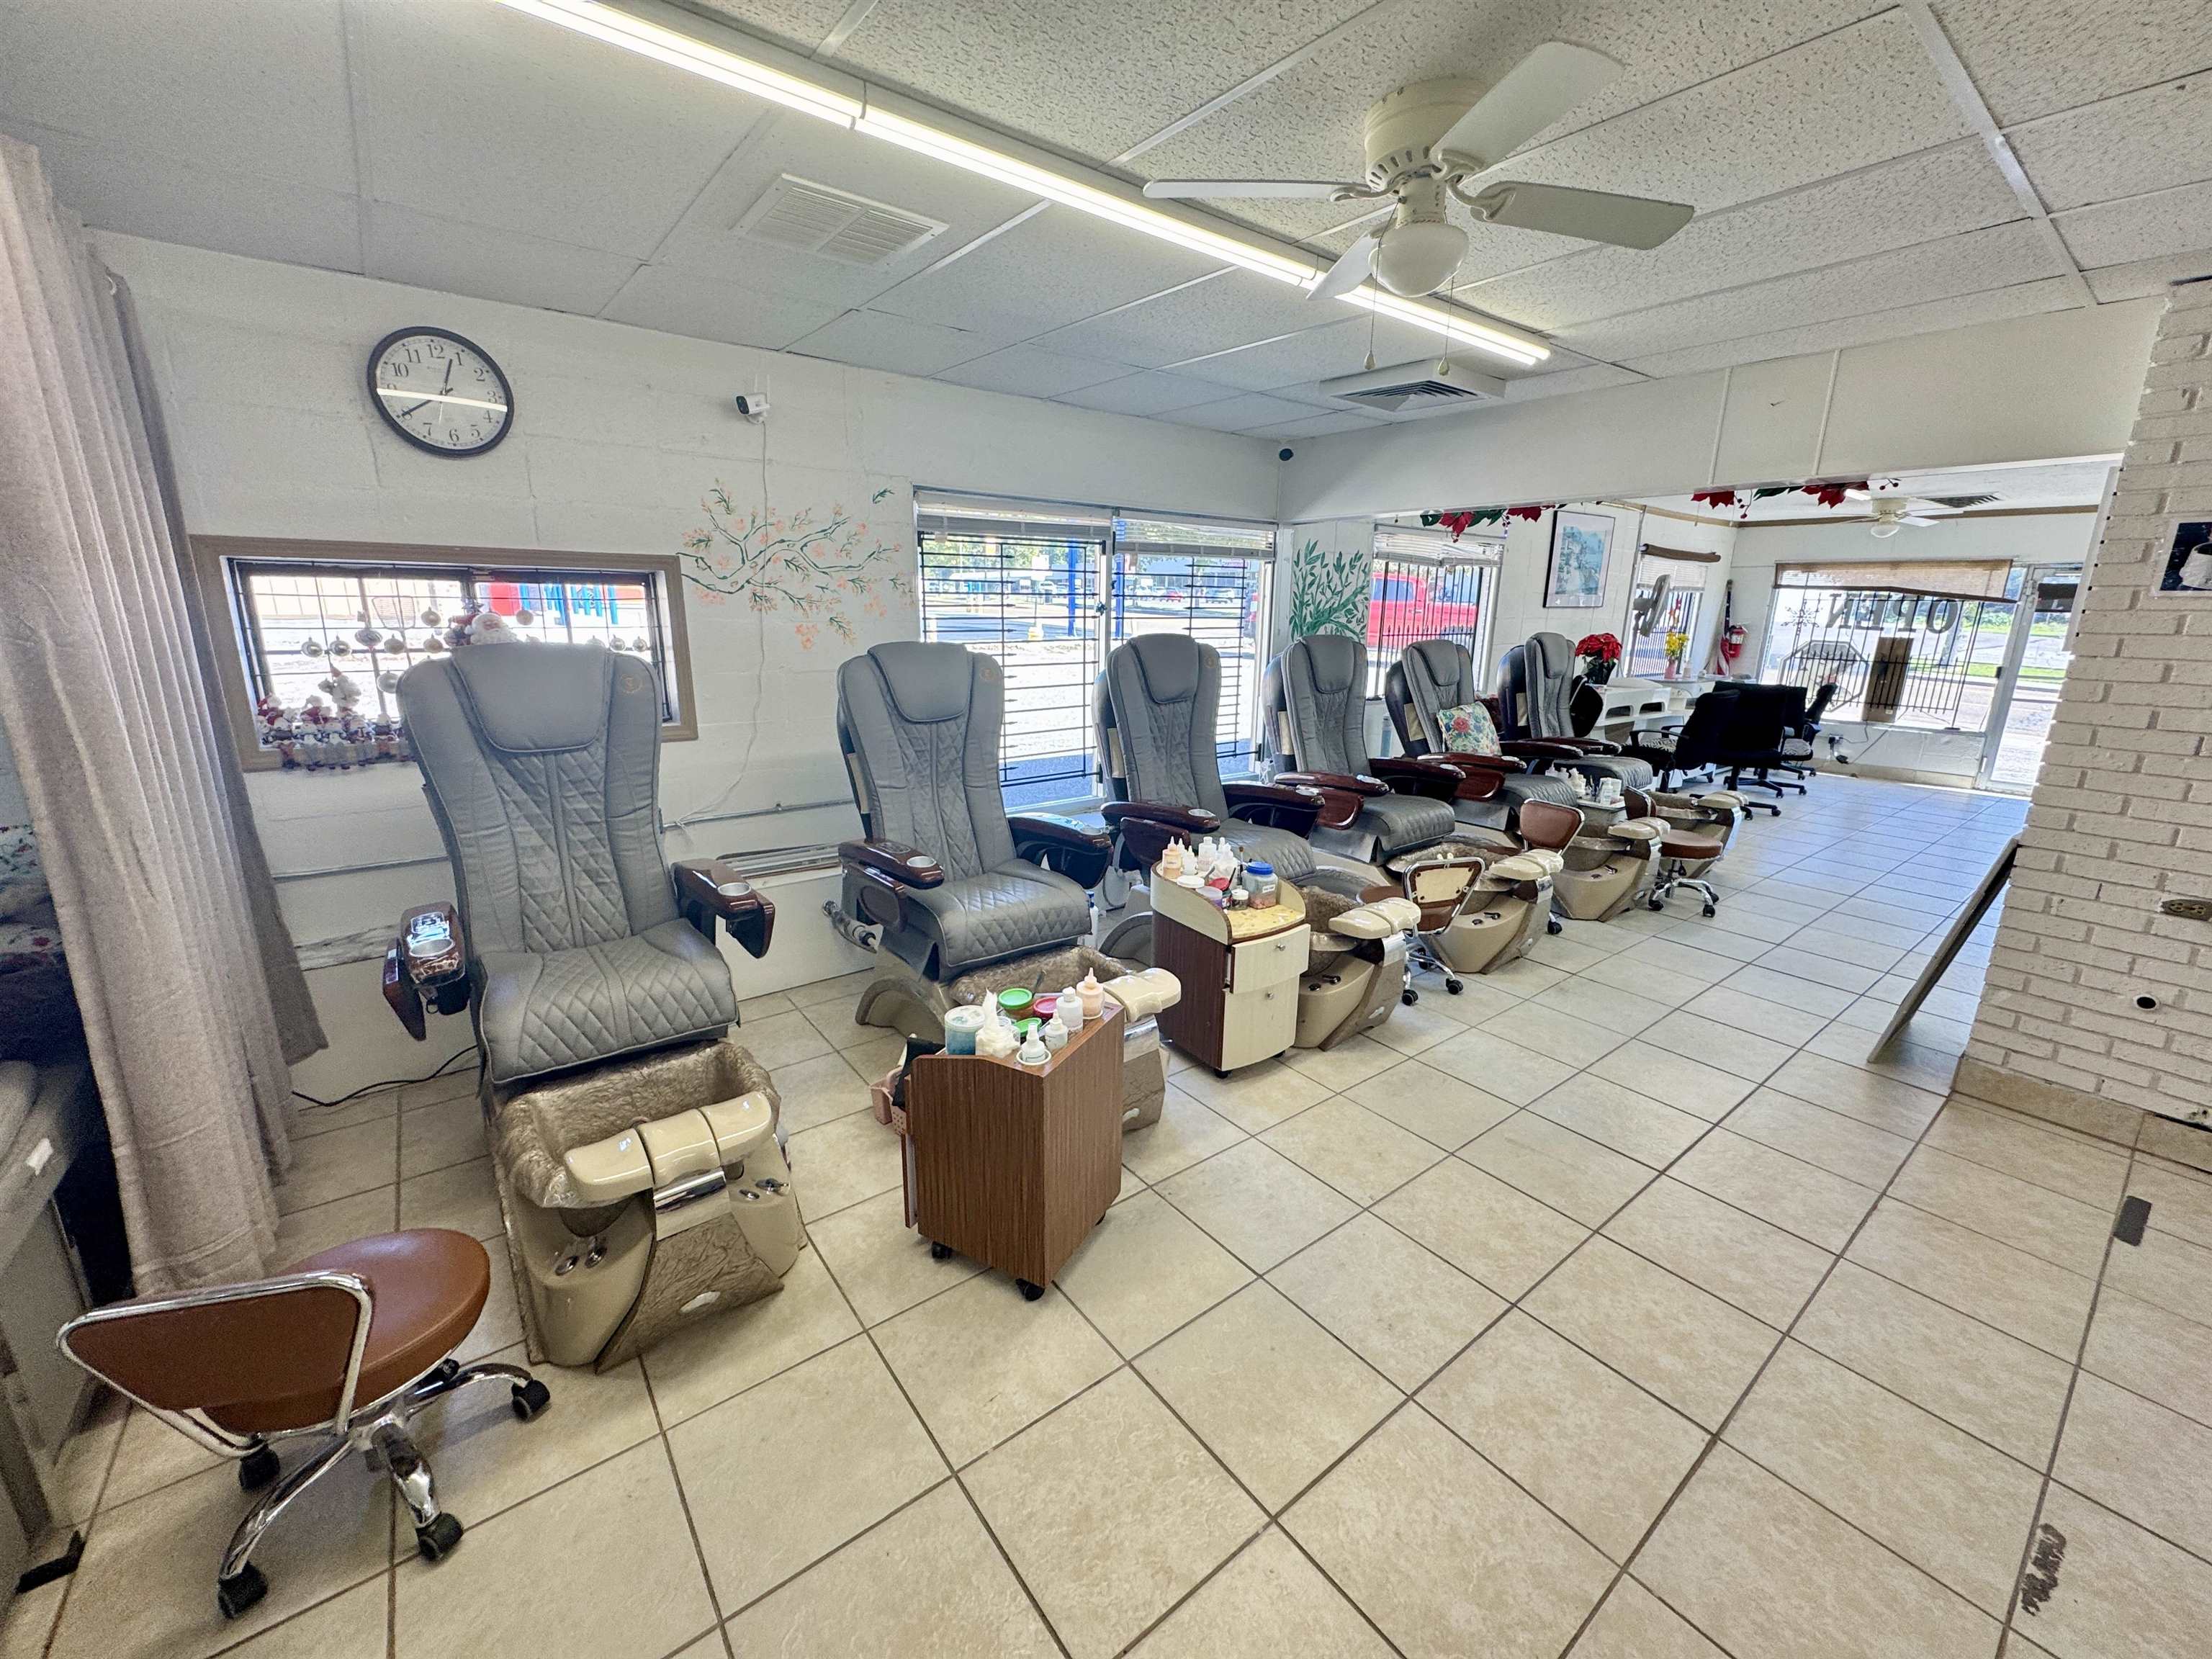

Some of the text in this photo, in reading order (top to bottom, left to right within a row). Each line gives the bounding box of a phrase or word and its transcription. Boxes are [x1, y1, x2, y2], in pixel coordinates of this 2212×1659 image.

[405, 349, 421, 363] 11
[427, 344, 445, 359] 12
[455, 352, 462, 366] 1
[392, 362, 408, 377] 10
[474, 368, 485, 382] 2
[487, 390, 498, 404] 3
[482, 410, 493, 423] 4
[423, 423, 432, 436] 7
[449, 429, 459, 442] 6
[471, 424, 480, 438] 5
